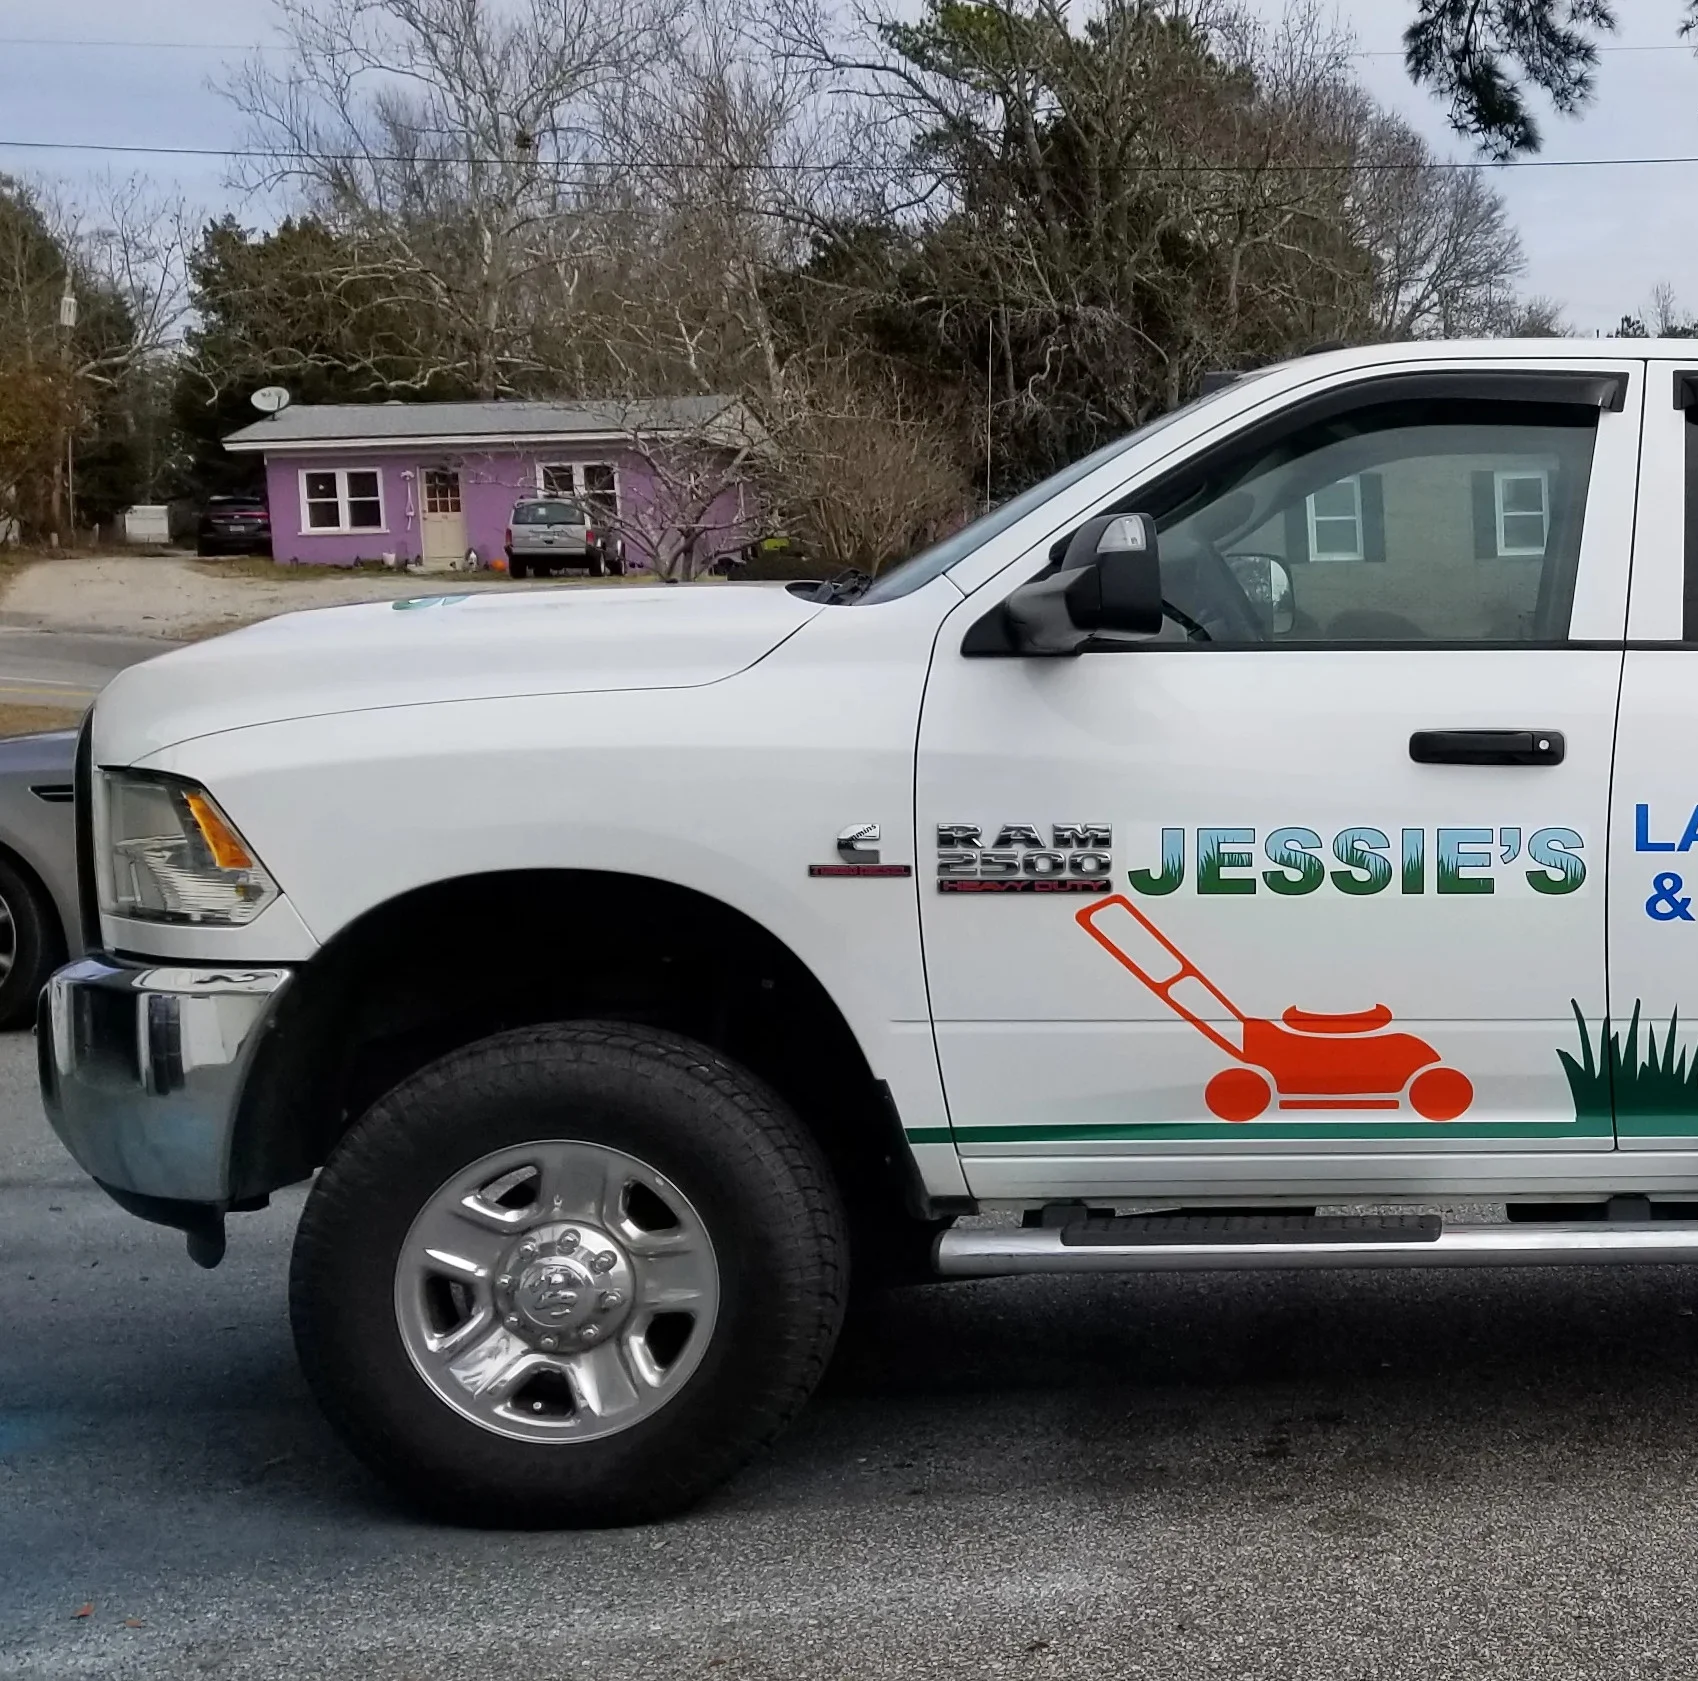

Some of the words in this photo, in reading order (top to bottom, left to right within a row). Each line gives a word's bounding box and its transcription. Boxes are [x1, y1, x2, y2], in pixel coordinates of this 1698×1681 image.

[937, 823, 1112, 848] RAM
[937, 850, 1112, 877] 2500
[1127, 826, 1587, 896] JESSIE'S
[942, 880, 1030, 892] HEAVY
[1034, 880, 1108, 892] DUTY
[1645, 872, 1695, 921] &
